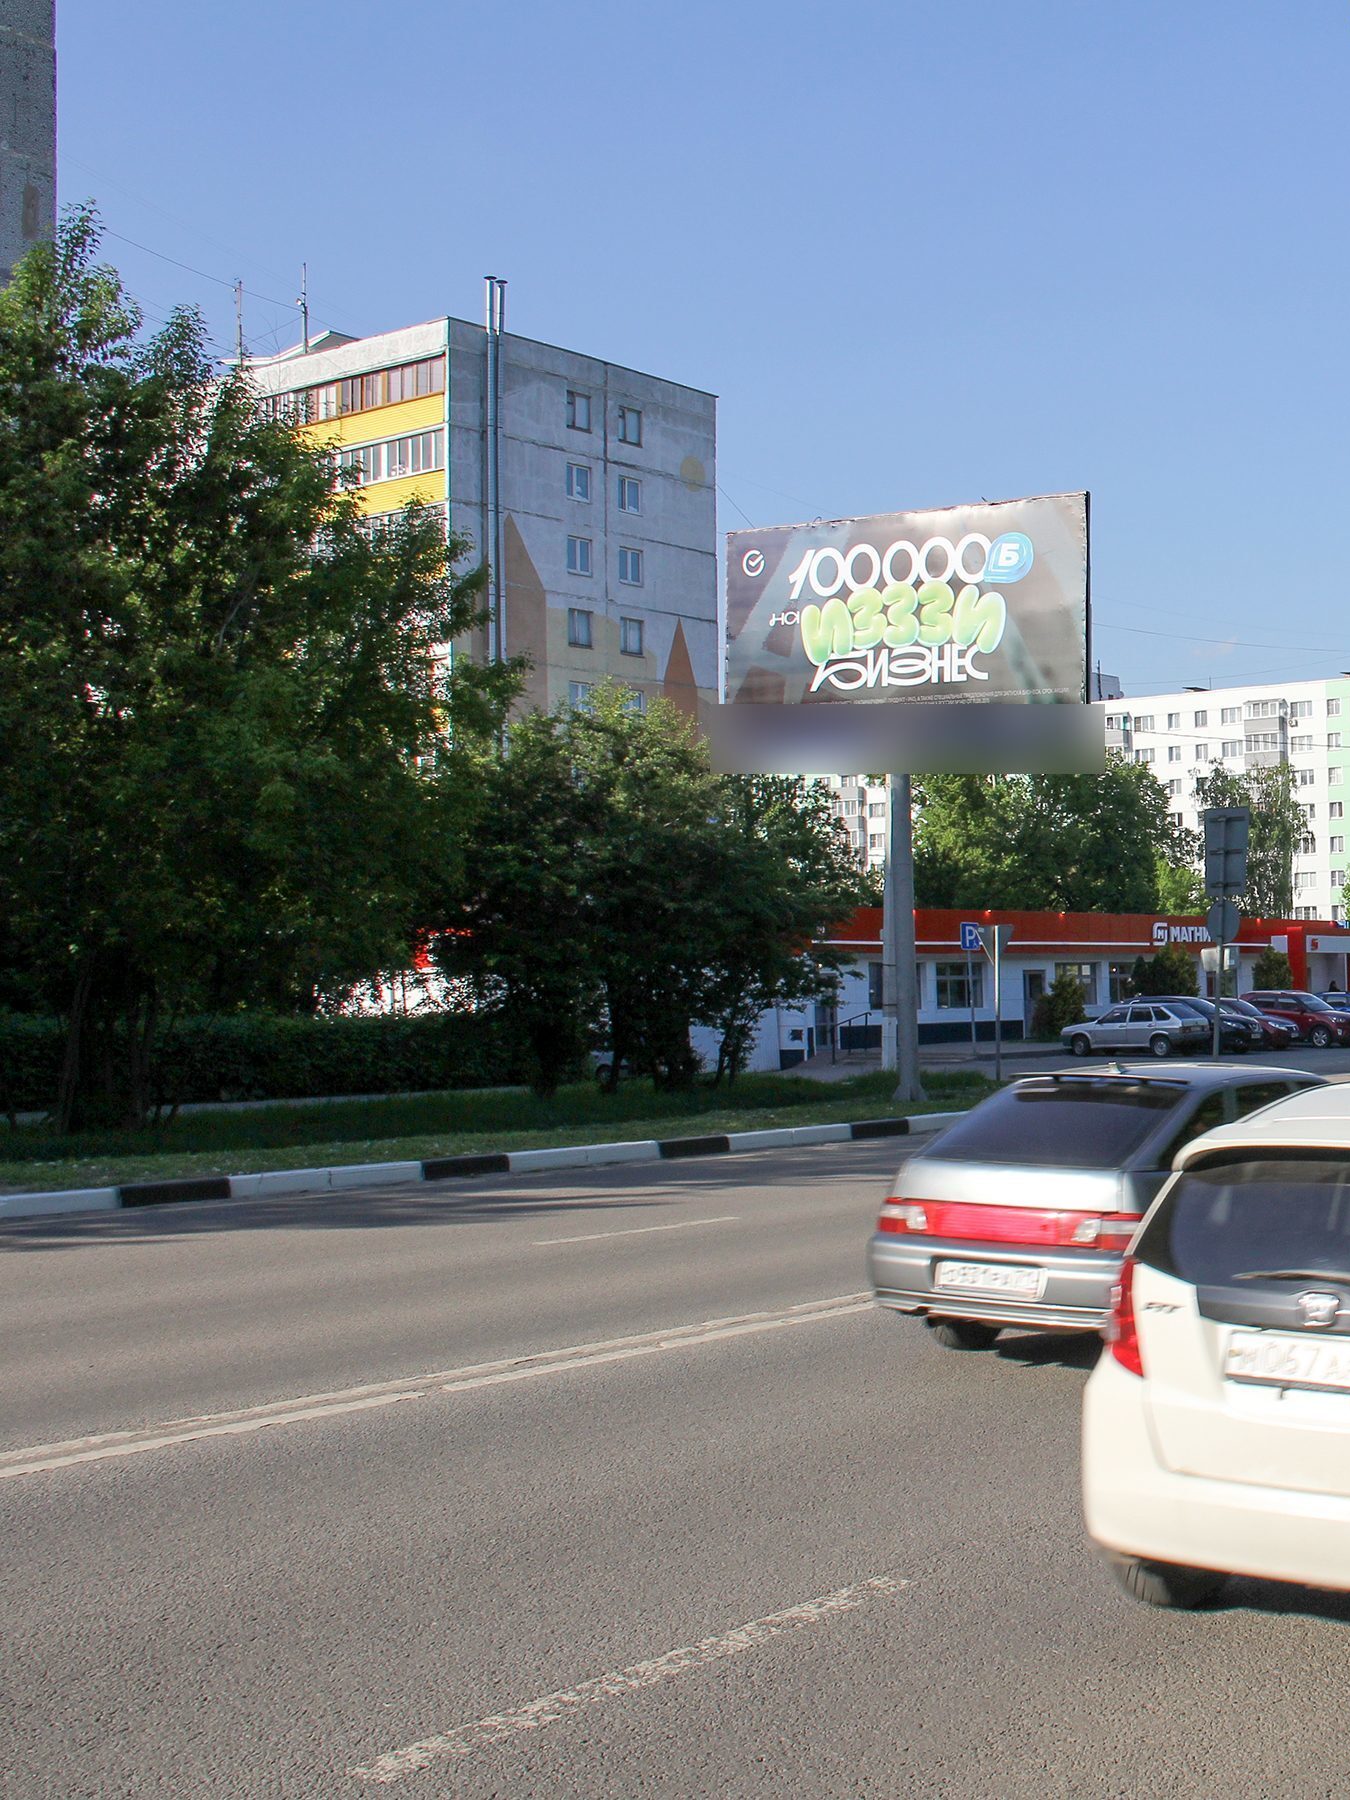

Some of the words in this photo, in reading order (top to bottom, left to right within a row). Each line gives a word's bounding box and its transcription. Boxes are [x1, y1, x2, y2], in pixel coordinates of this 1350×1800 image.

[788, 532, 991, 599] 100000
[810, 642, 990, 693] БИЗНЕС
[1169, 926, 1212, 943] МАГНИ
